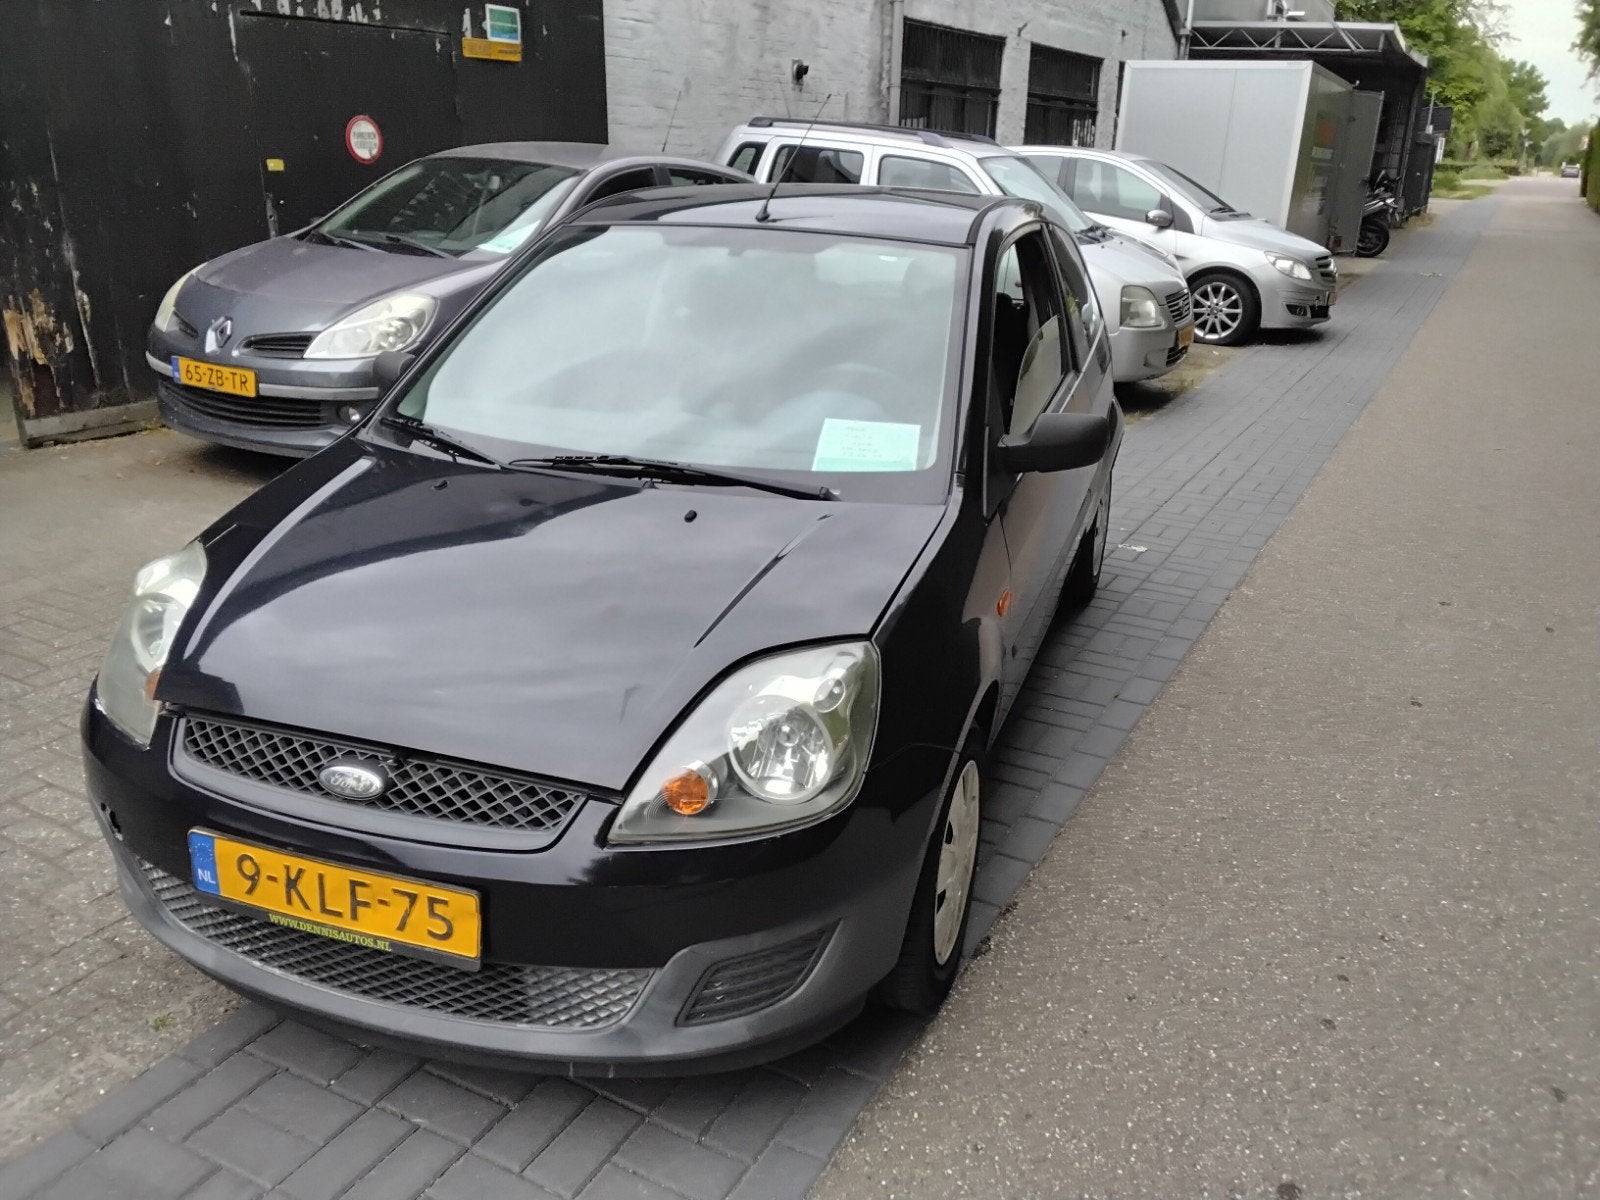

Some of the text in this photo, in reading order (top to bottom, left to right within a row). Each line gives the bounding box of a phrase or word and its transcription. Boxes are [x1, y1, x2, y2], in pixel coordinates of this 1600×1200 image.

[185, 364, 249, 392] 65-ZB-TR
[198, 853, 454, 942] NL 9-KLF-75
[268, 913, 392, 952] WWW.DENNISAUTOS.NL
